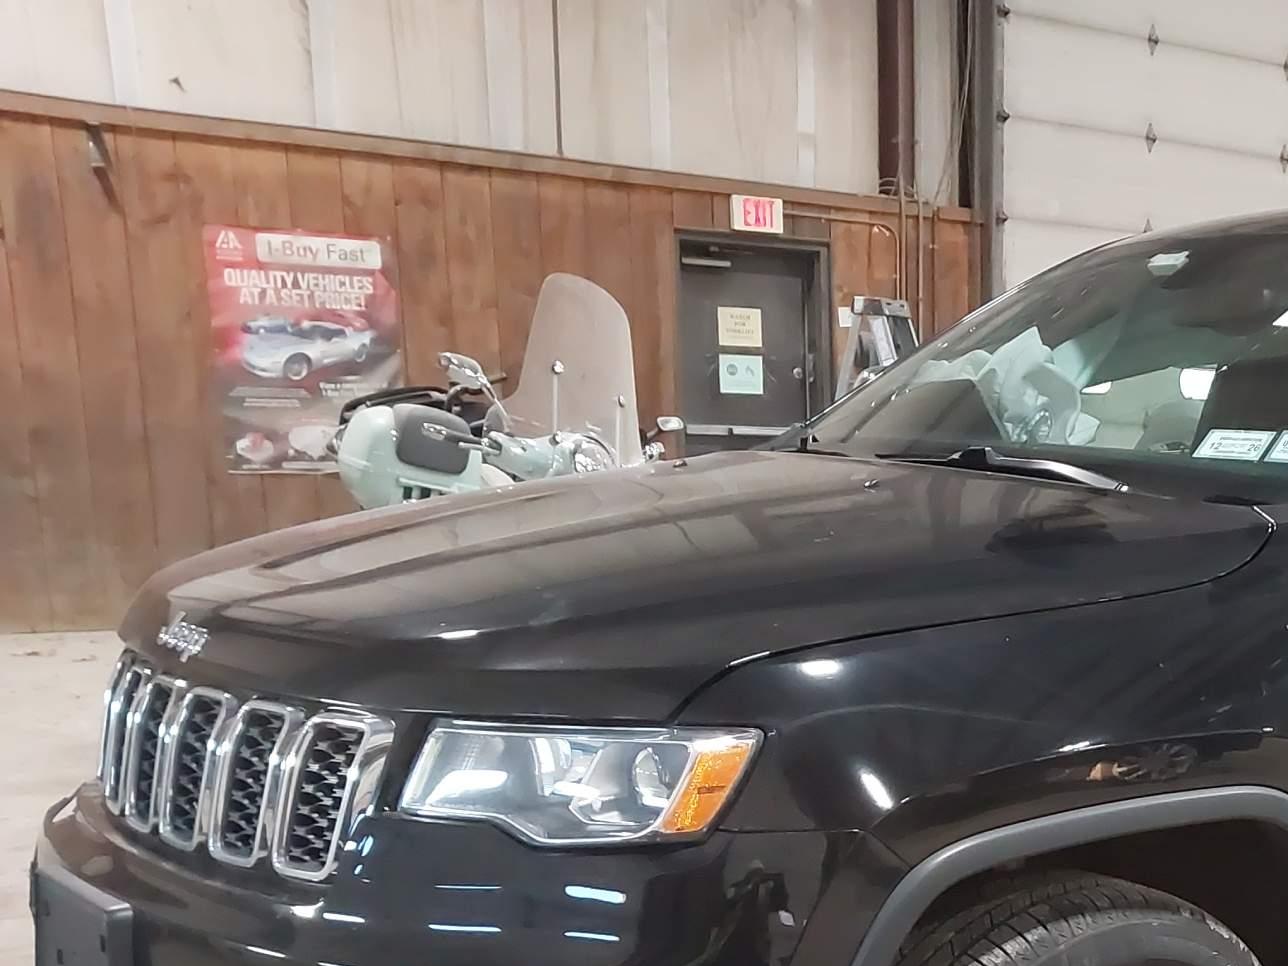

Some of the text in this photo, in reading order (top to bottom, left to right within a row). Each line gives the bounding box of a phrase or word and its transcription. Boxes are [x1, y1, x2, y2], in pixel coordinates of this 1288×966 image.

[743, 198, 776, 229] EXIT
[267, 240, 320, 262] I-Buy
[327, 243, 366, 263] Fast
[223, 267, 374, 294] QUALITY VEHICLES
[240, 288, 367, 311] AT A SET PRICE!
[1208, 441, 1223, 450] 12
